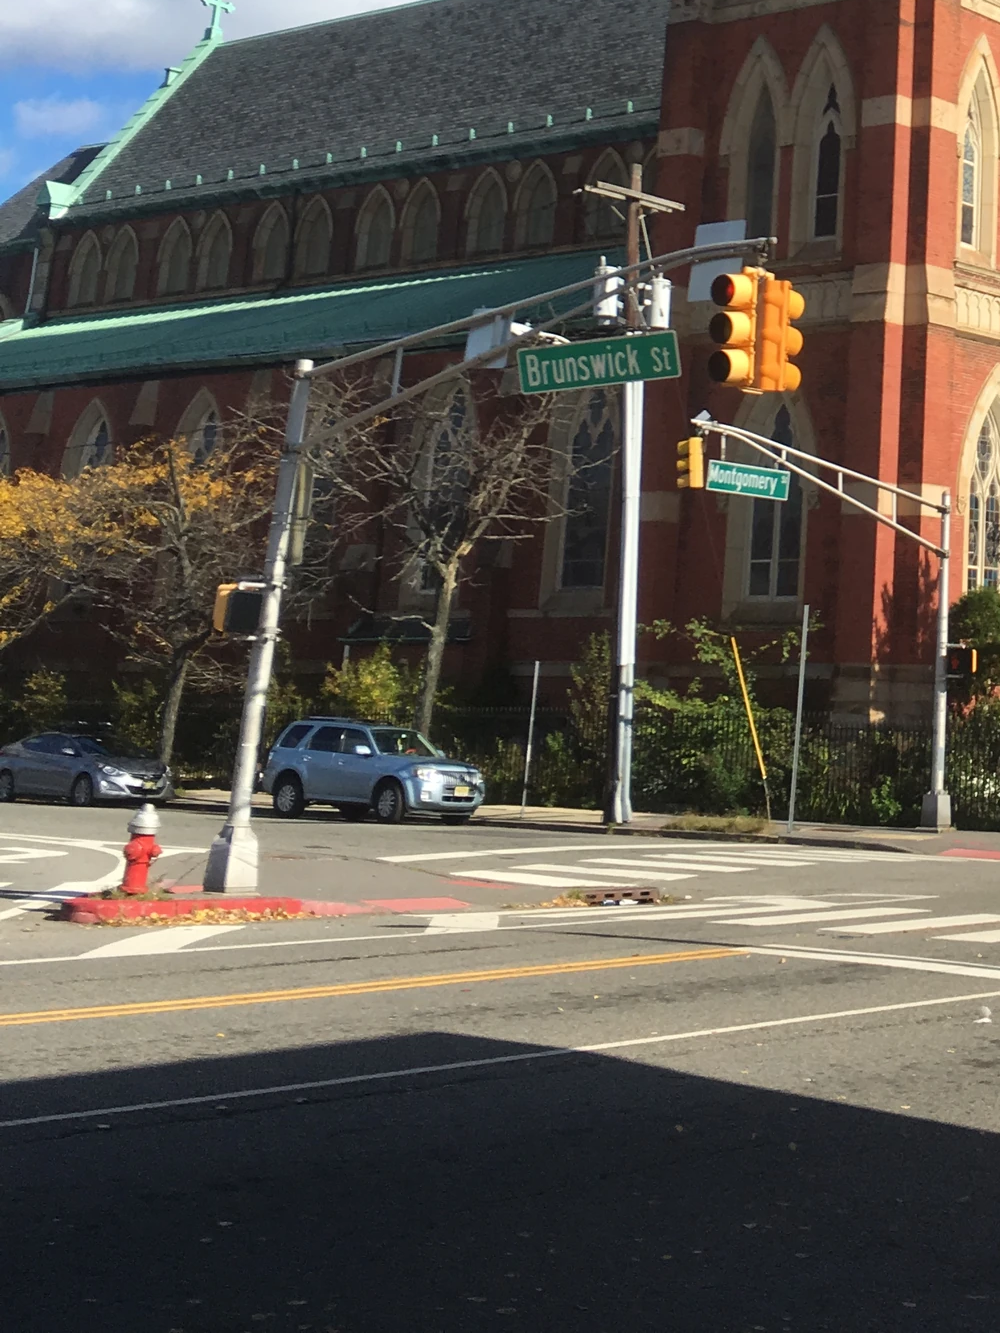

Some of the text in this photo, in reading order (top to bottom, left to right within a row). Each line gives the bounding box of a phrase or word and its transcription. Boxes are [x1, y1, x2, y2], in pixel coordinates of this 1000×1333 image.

[525, 343, 671, 387] Brunswick St
[709, 464, 778, 495] Montgomery
